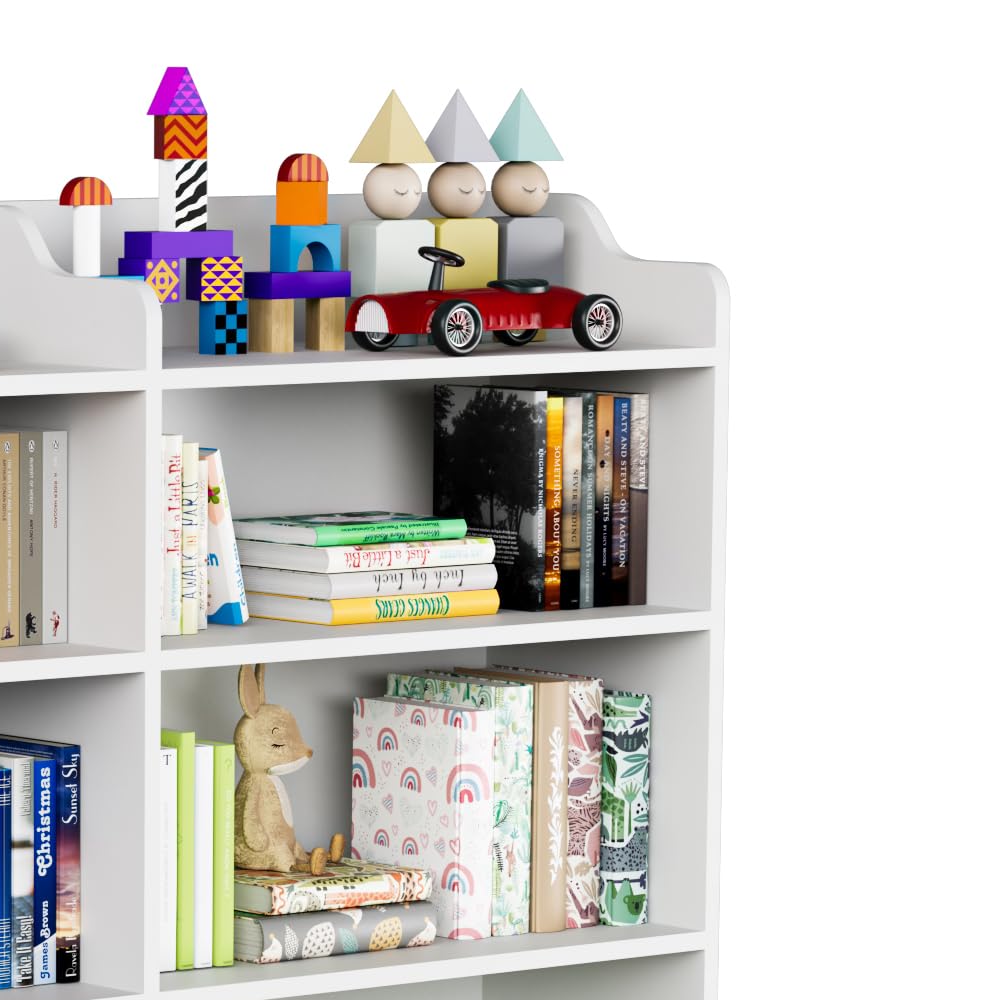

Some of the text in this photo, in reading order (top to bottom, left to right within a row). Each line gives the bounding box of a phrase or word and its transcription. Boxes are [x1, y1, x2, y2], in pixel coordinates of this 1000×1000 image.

[620, 402, 628, 433] BEATY
[620, 436, 628, 457] AND
[620, 460, 628, 490] STEVE
[638, 436, 647, 490] AND STEVE
[537, 479, 544, 488] BY
[571, 469, 579, 501] NEVER
[182, 481, 199, 527] PARIS
[552, 445, 561, 571] SOMETHING ABOUT YOU
[619, 498, 627, 513] ON
[166, 529, 181, 556] Just
[394, 550, 402, 560] a
[619, 516, 627, 568] VACATION
[344, 552, 361, 569] Bit
[362, 551, 393, 568] Little
[407, 549, 431, 566] Just
[373, 568, 464, 592] Inch by Inch
[375, 595, 450, 620] CHANGES GEARS
[61, 753, 80, 825] Sunset Sky
[36, 766, 53, 877] Christmas
[40, 900, 51, 939] Brown
[15, 915, 34, 983] Take It Easy!
